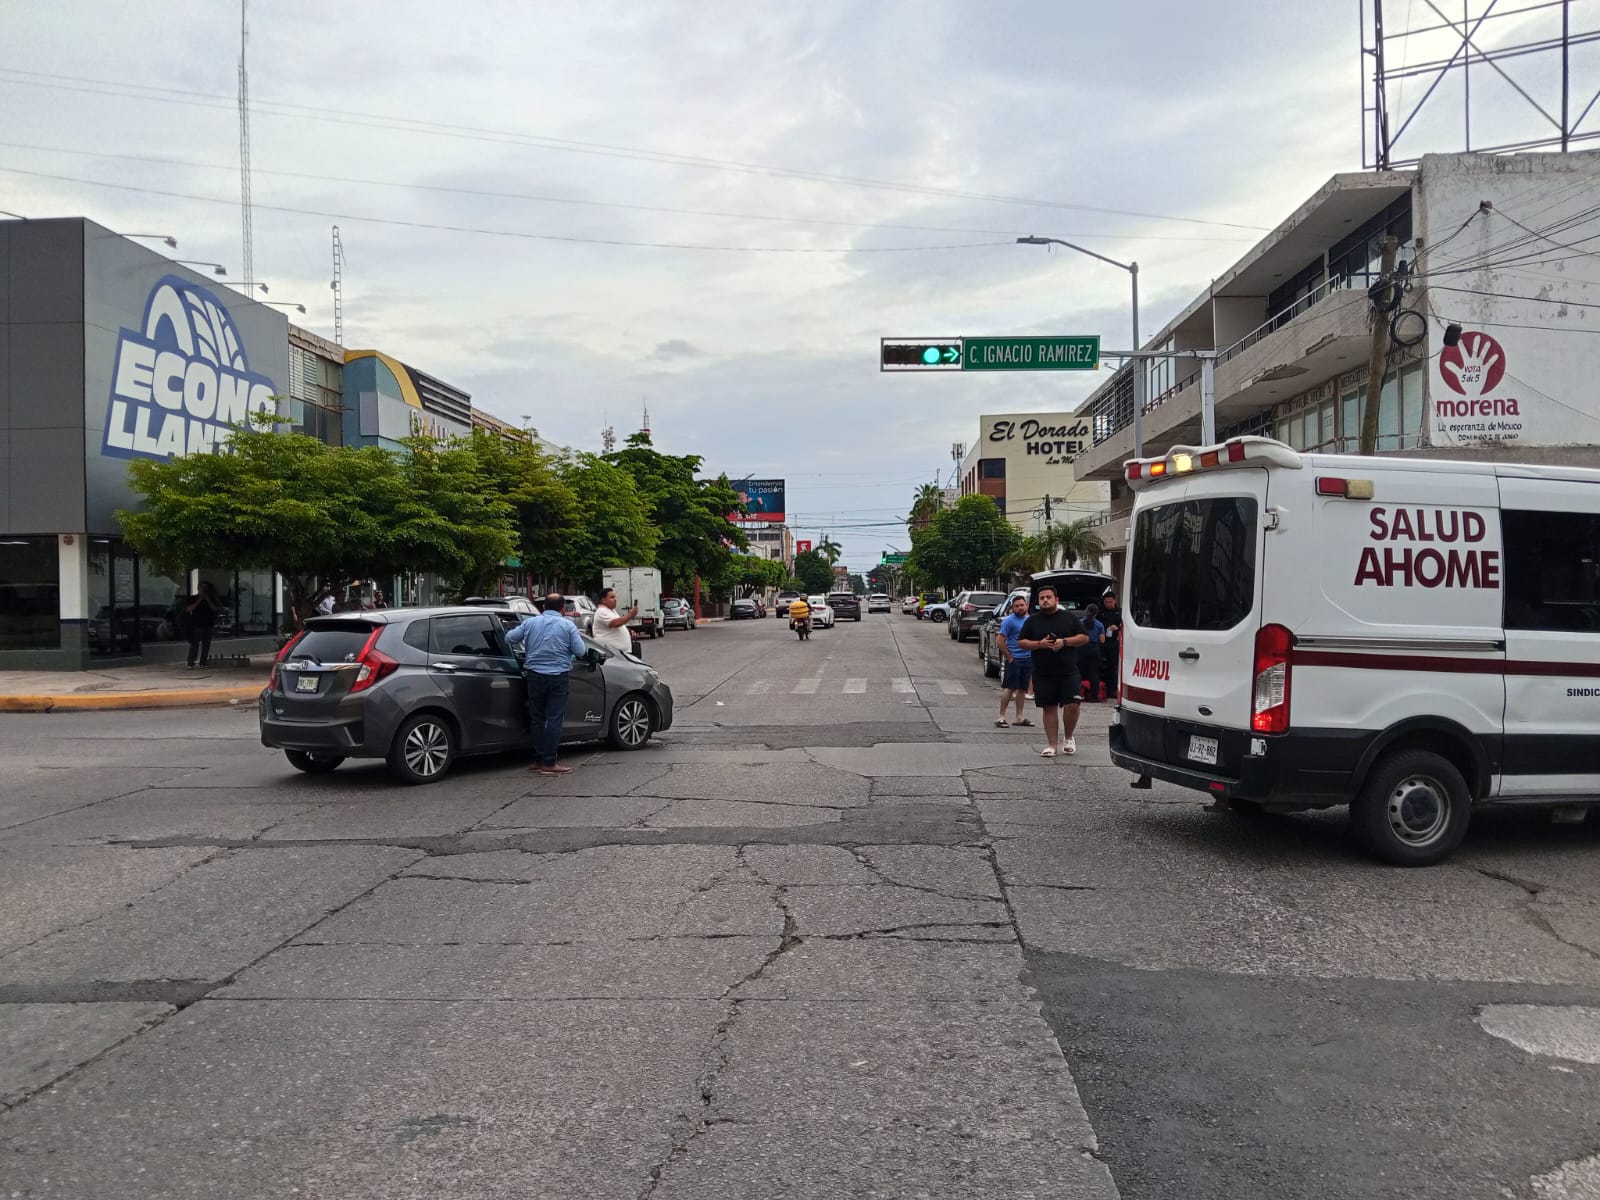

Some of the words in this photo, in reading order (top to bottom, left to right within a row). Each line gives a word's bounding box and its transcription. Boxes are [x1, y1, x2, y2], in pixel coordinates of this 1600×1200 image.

[970, 345, 980, 363] C.
[983, 344, 1033, 363] IGNACIO
[1038, 344, 1093, 362] RAMIREZ
[1464, 365, 1482, 374] VOTA
[115, 339, 276, 433] ECONO
[1437, 398, 1520, 417] morena
[106, 399, 240, 458] LLANT
[989, 421, 1016, 442] El
[1020, 419, 1090, 441] Dorado
[1437, 422, 1447, 432] La
[1449, 423, 1486, 433] esperanza
[1487, 421, 1496, 431] de
[1026, 440, 1085, 455] HOTEL
[1369, 507, 1487, 543] SALUD
[1354, 546, 1501, 590] AHOME
[1131, 657, 1171, 681] AMBUL
[1566, 688, 1600, 697] SINDIC
